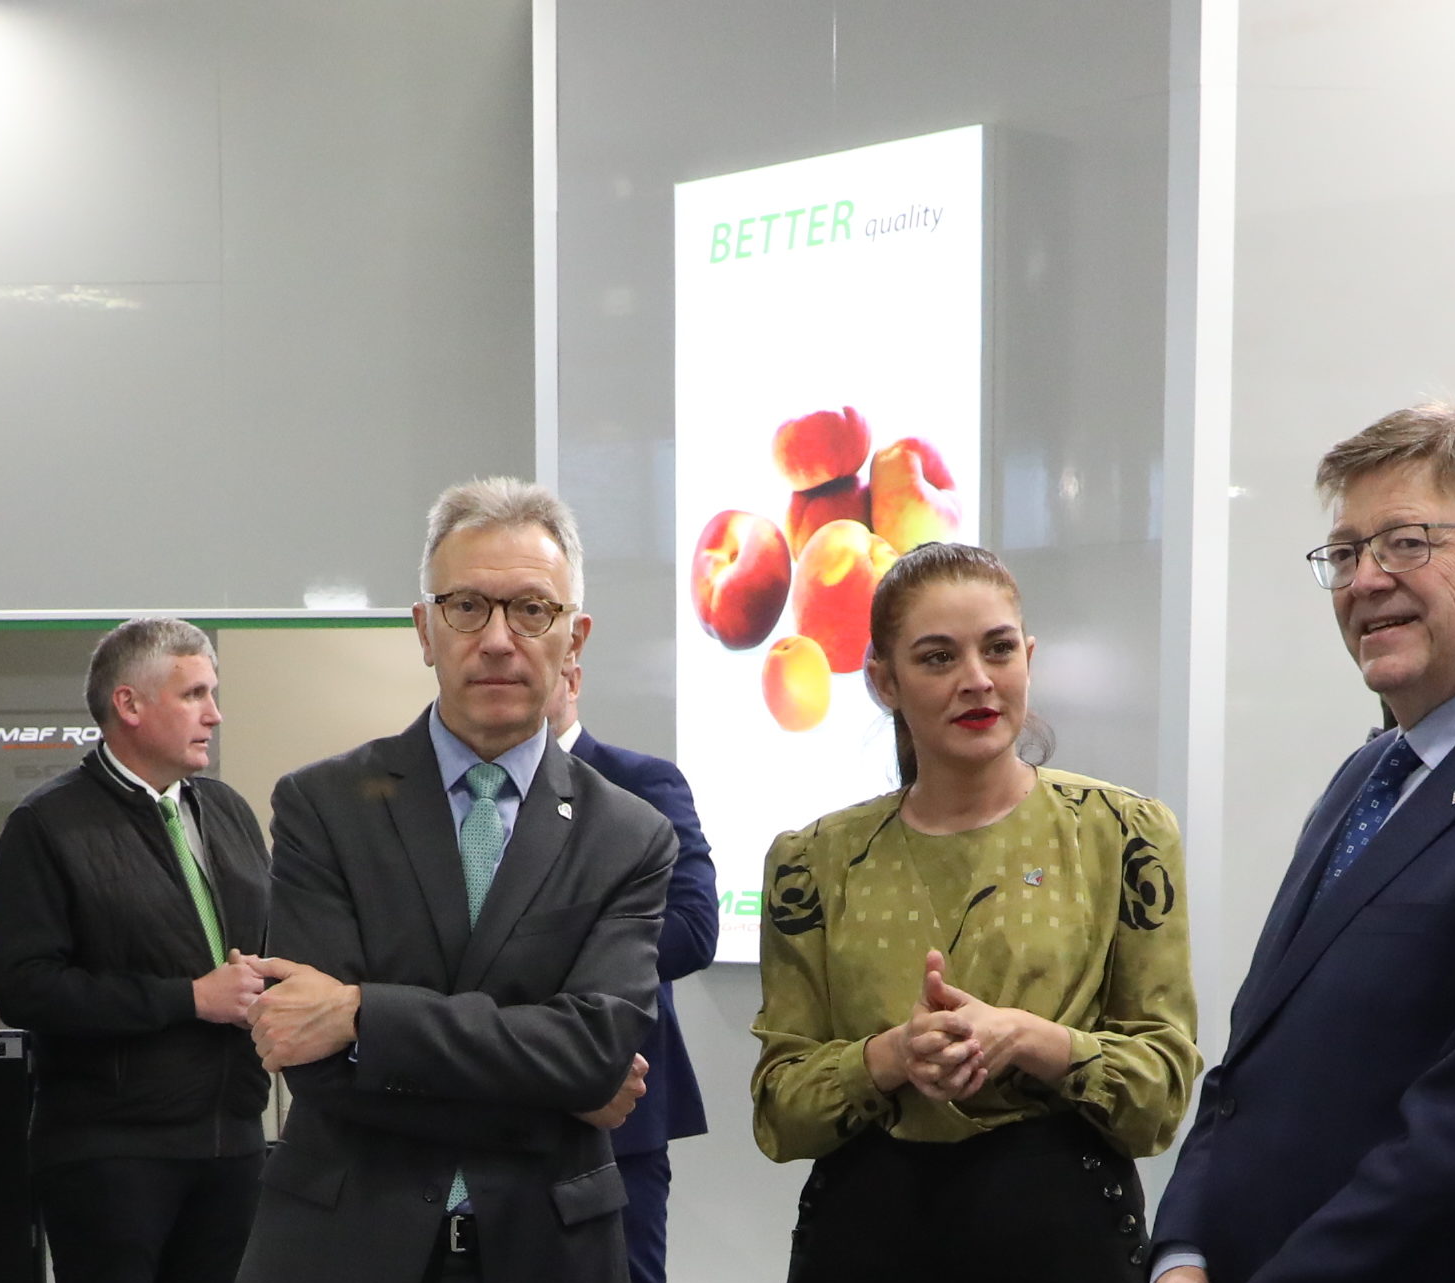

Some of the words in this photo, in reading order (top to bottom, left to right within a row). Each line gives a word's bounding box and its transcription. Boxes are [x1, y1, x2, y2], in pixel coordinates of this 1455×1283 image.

[710, 200, 854, 263] BETTER
[865, 204, 943, 242] quality
[62, 727, 102, 745] RO
